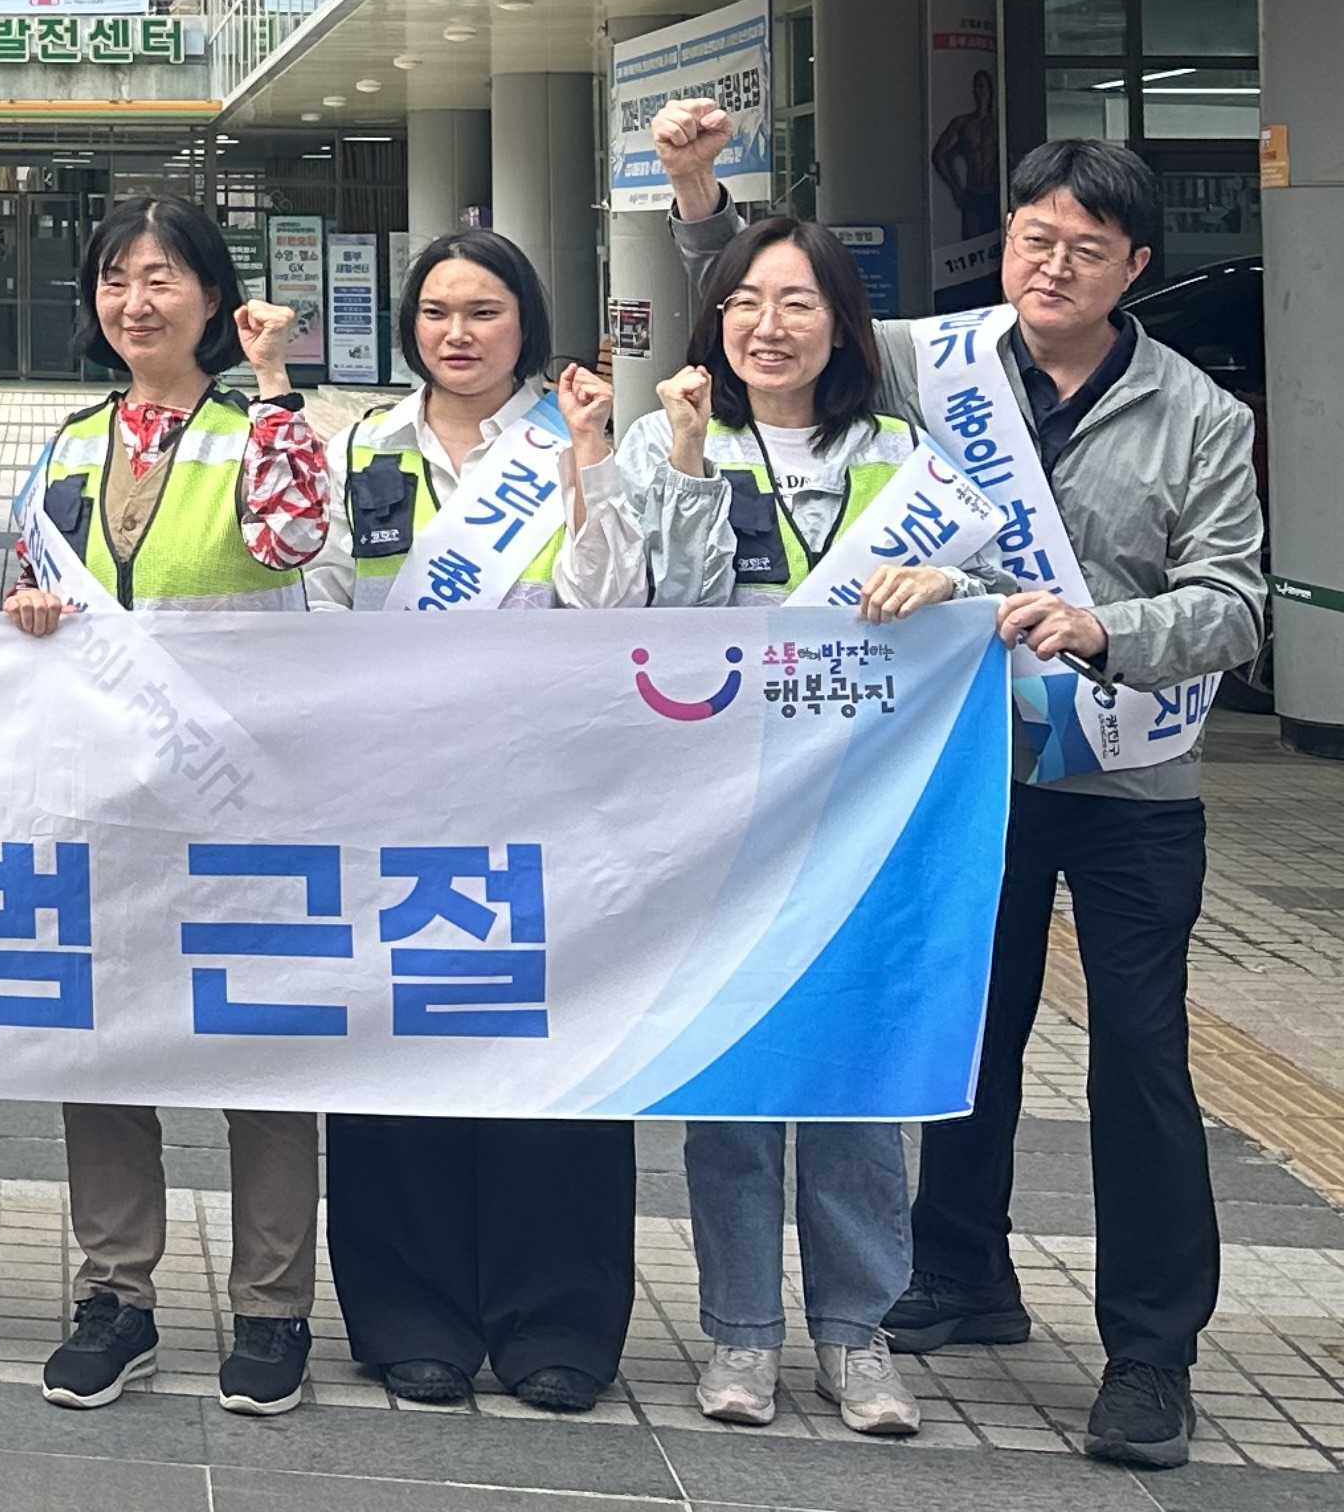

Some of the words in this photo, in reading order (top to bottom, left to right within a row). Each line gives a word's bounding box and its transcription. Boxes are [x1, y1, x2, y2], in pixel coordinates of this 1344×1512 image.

[945, 386, 1015, 489] 좋은
[464, 459, 558, 553] 걷기
[763, 674, 895, 718] 행복광진
[181, 843, 550, 1039] 근절
